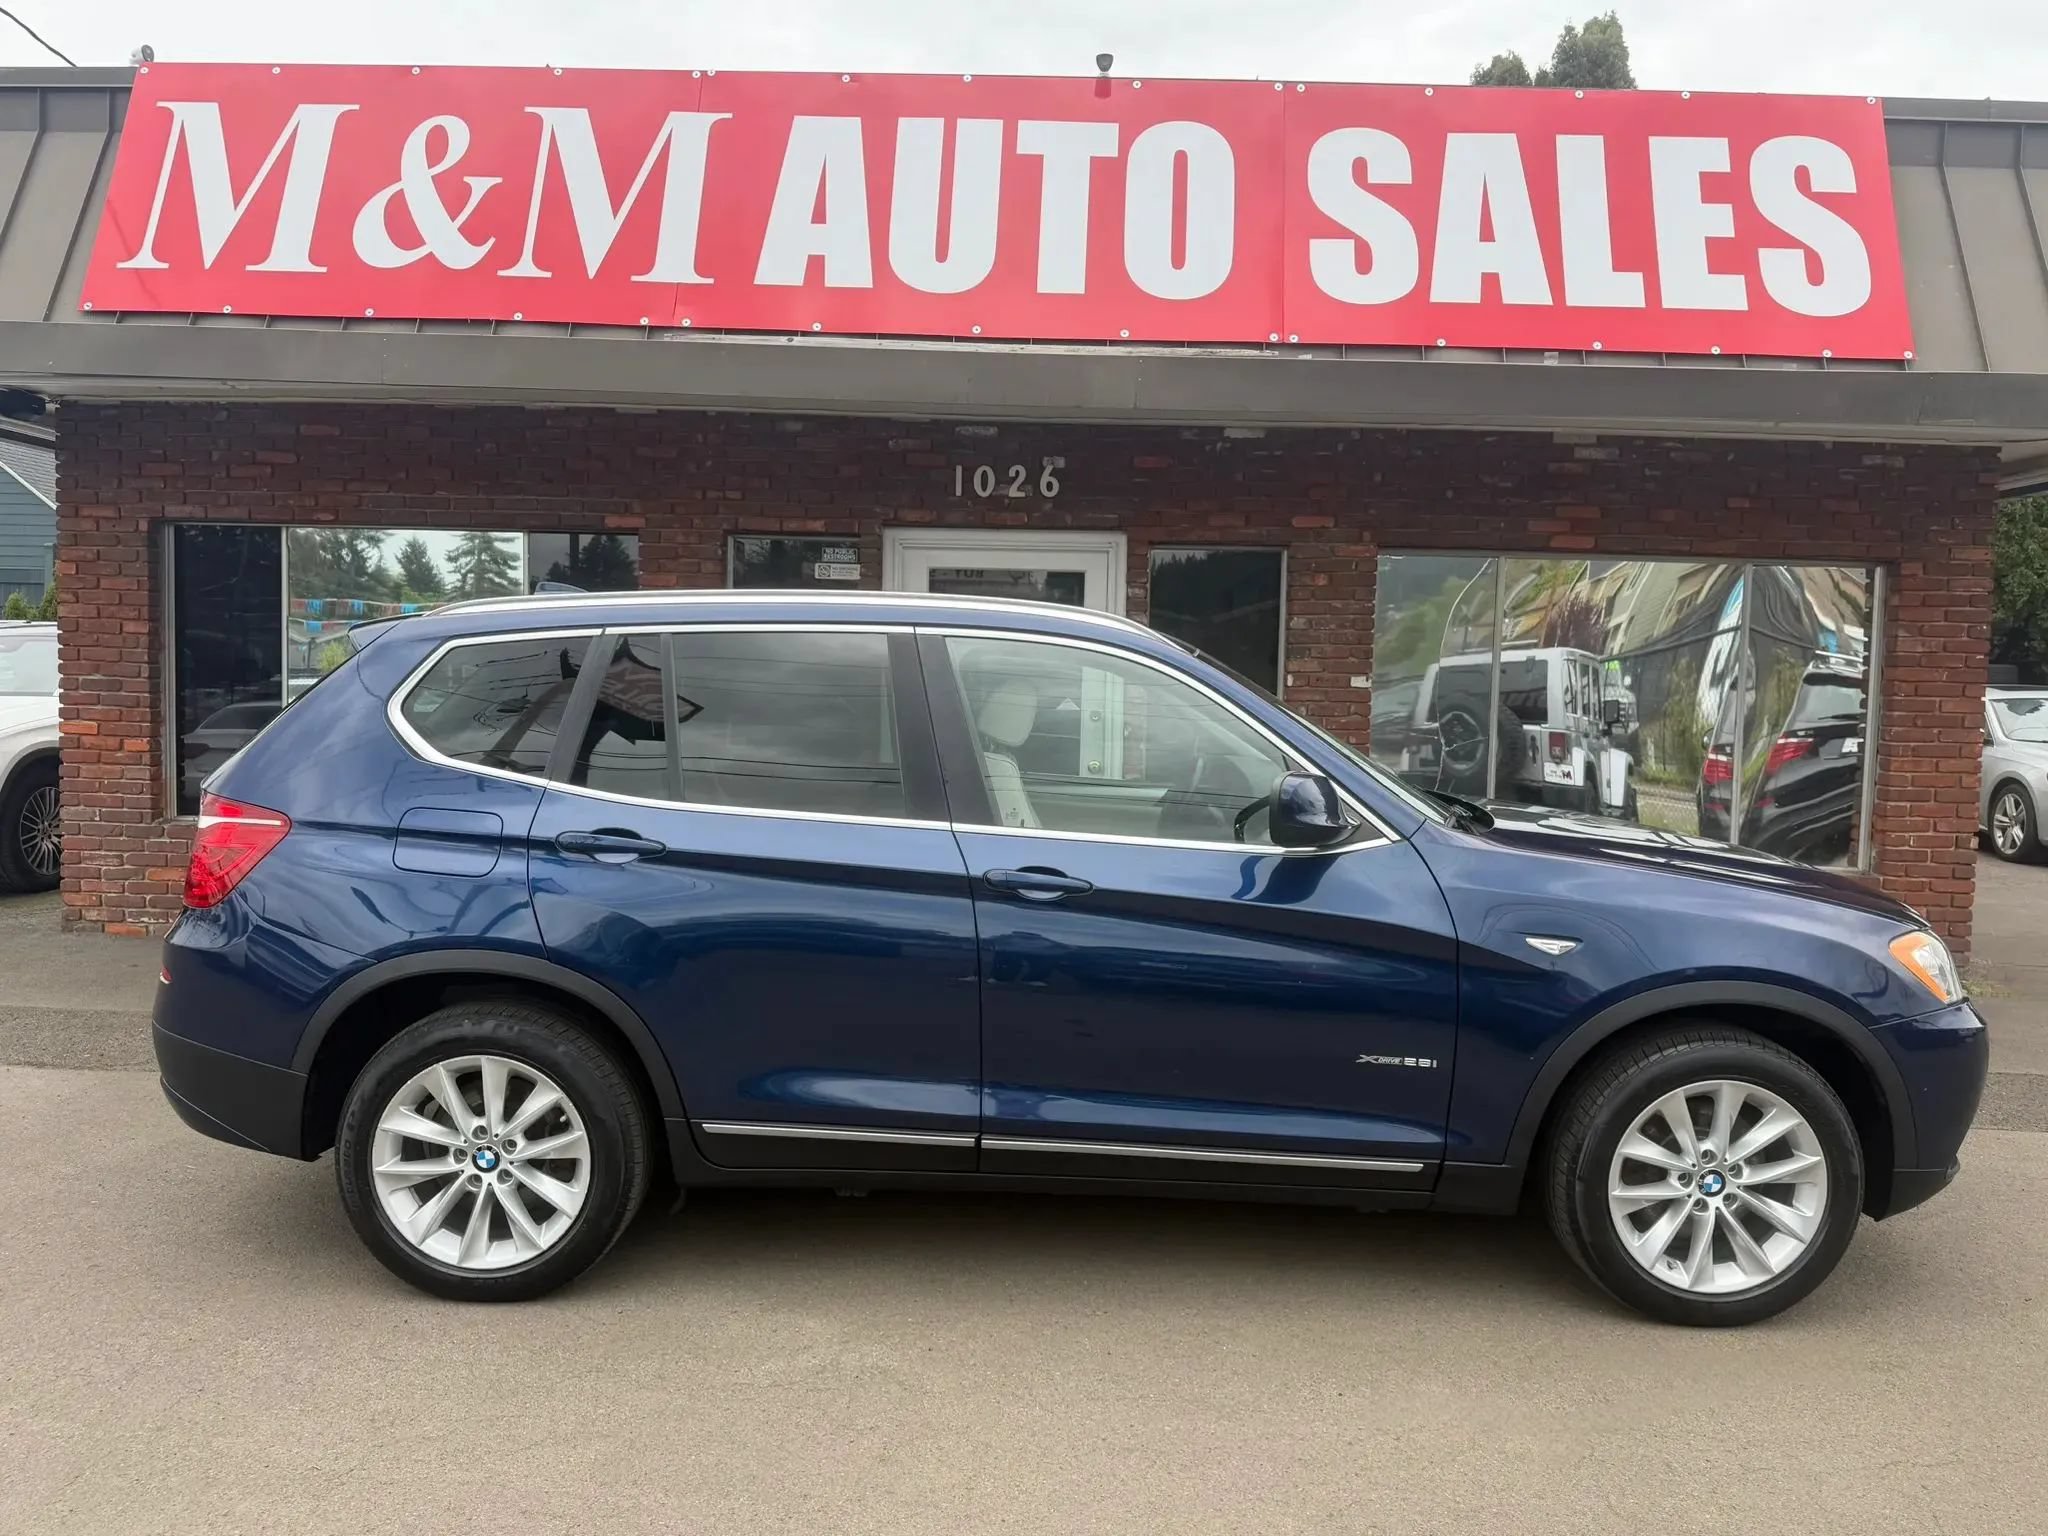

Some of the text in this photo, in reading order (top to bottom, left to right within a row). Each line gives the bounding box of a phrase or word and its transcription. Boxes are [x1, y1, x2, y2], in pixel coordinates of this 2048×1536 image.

[115, 101, 1872, 317] M&M AUTO SALES
[955, 464, 1060, 498] 1026
